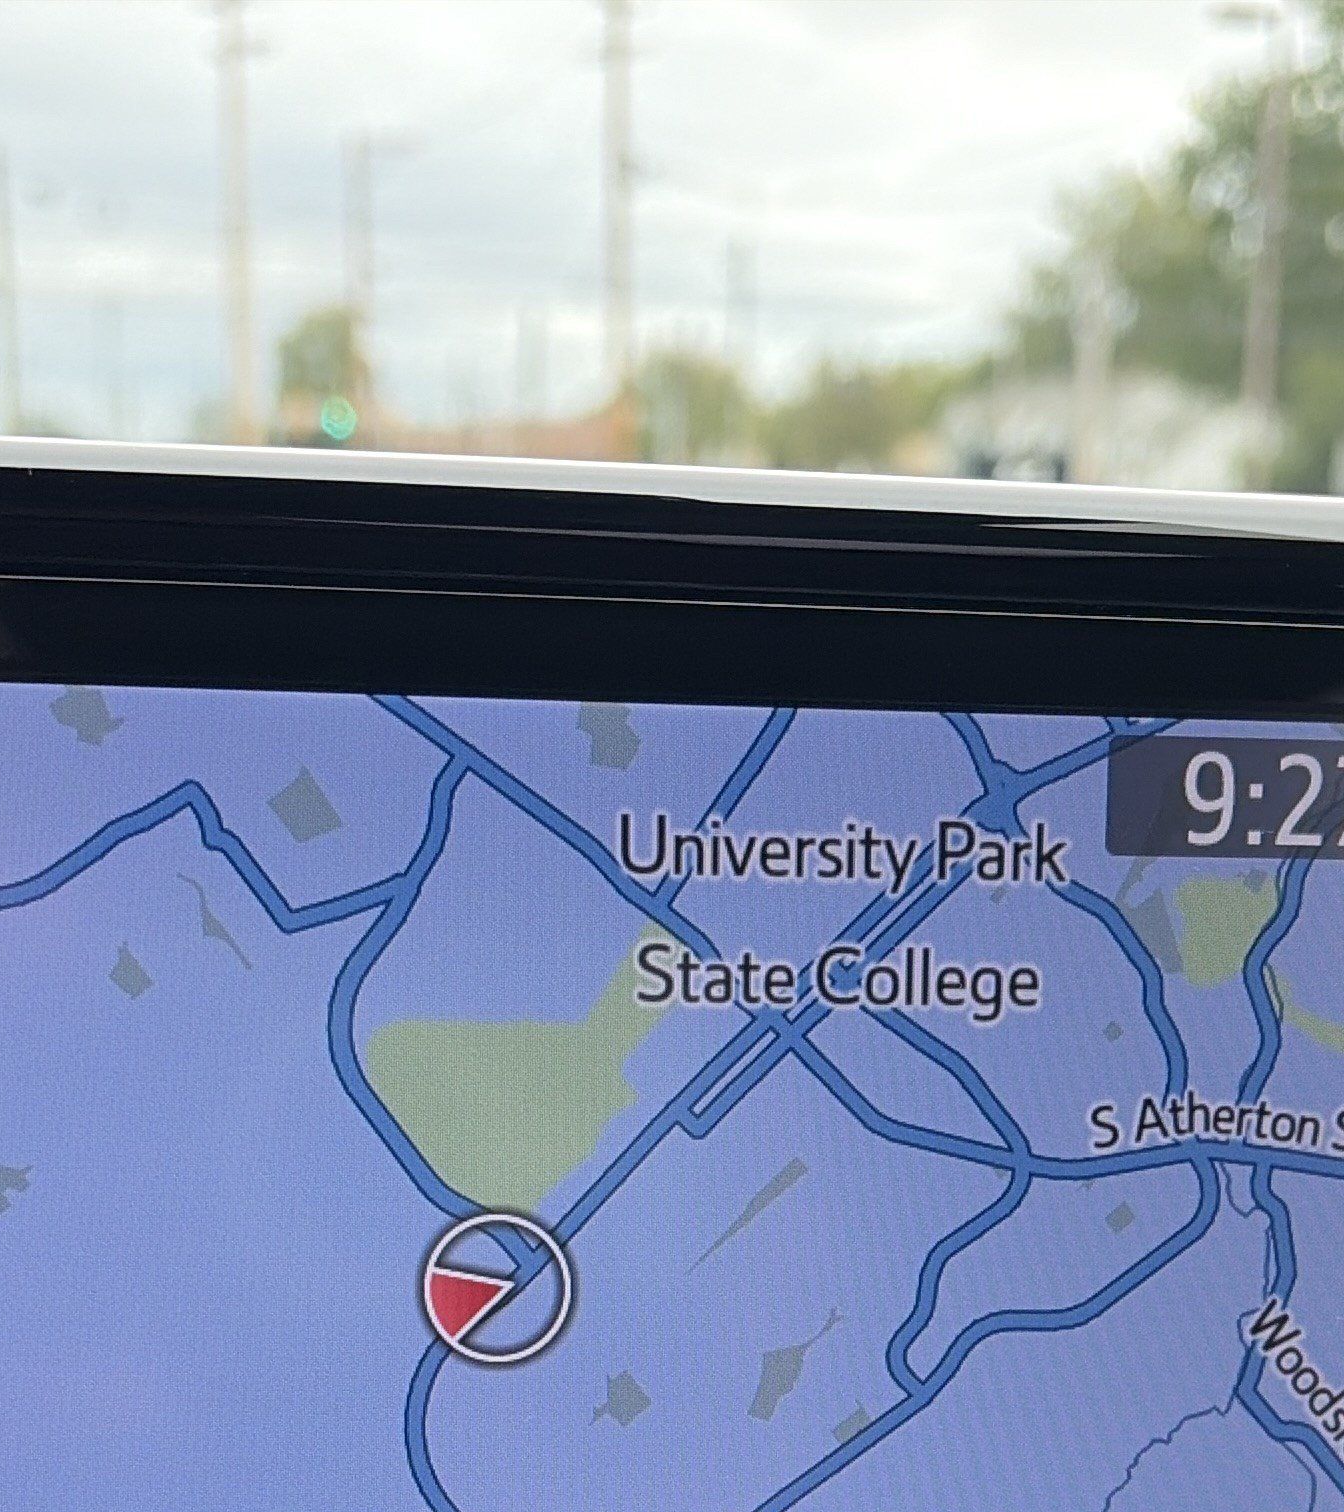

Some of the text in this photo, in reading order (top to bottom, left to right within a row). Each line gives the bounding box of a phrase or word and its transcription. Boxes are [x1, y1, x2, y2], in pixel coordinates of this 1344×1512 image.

[620, 813, 1069, 894] University Park
[636, 943, 1042, 1023] State College
[1090, 1103, 1120, 1150] S
[1134, 1094, 1322, 1149] Atherton
